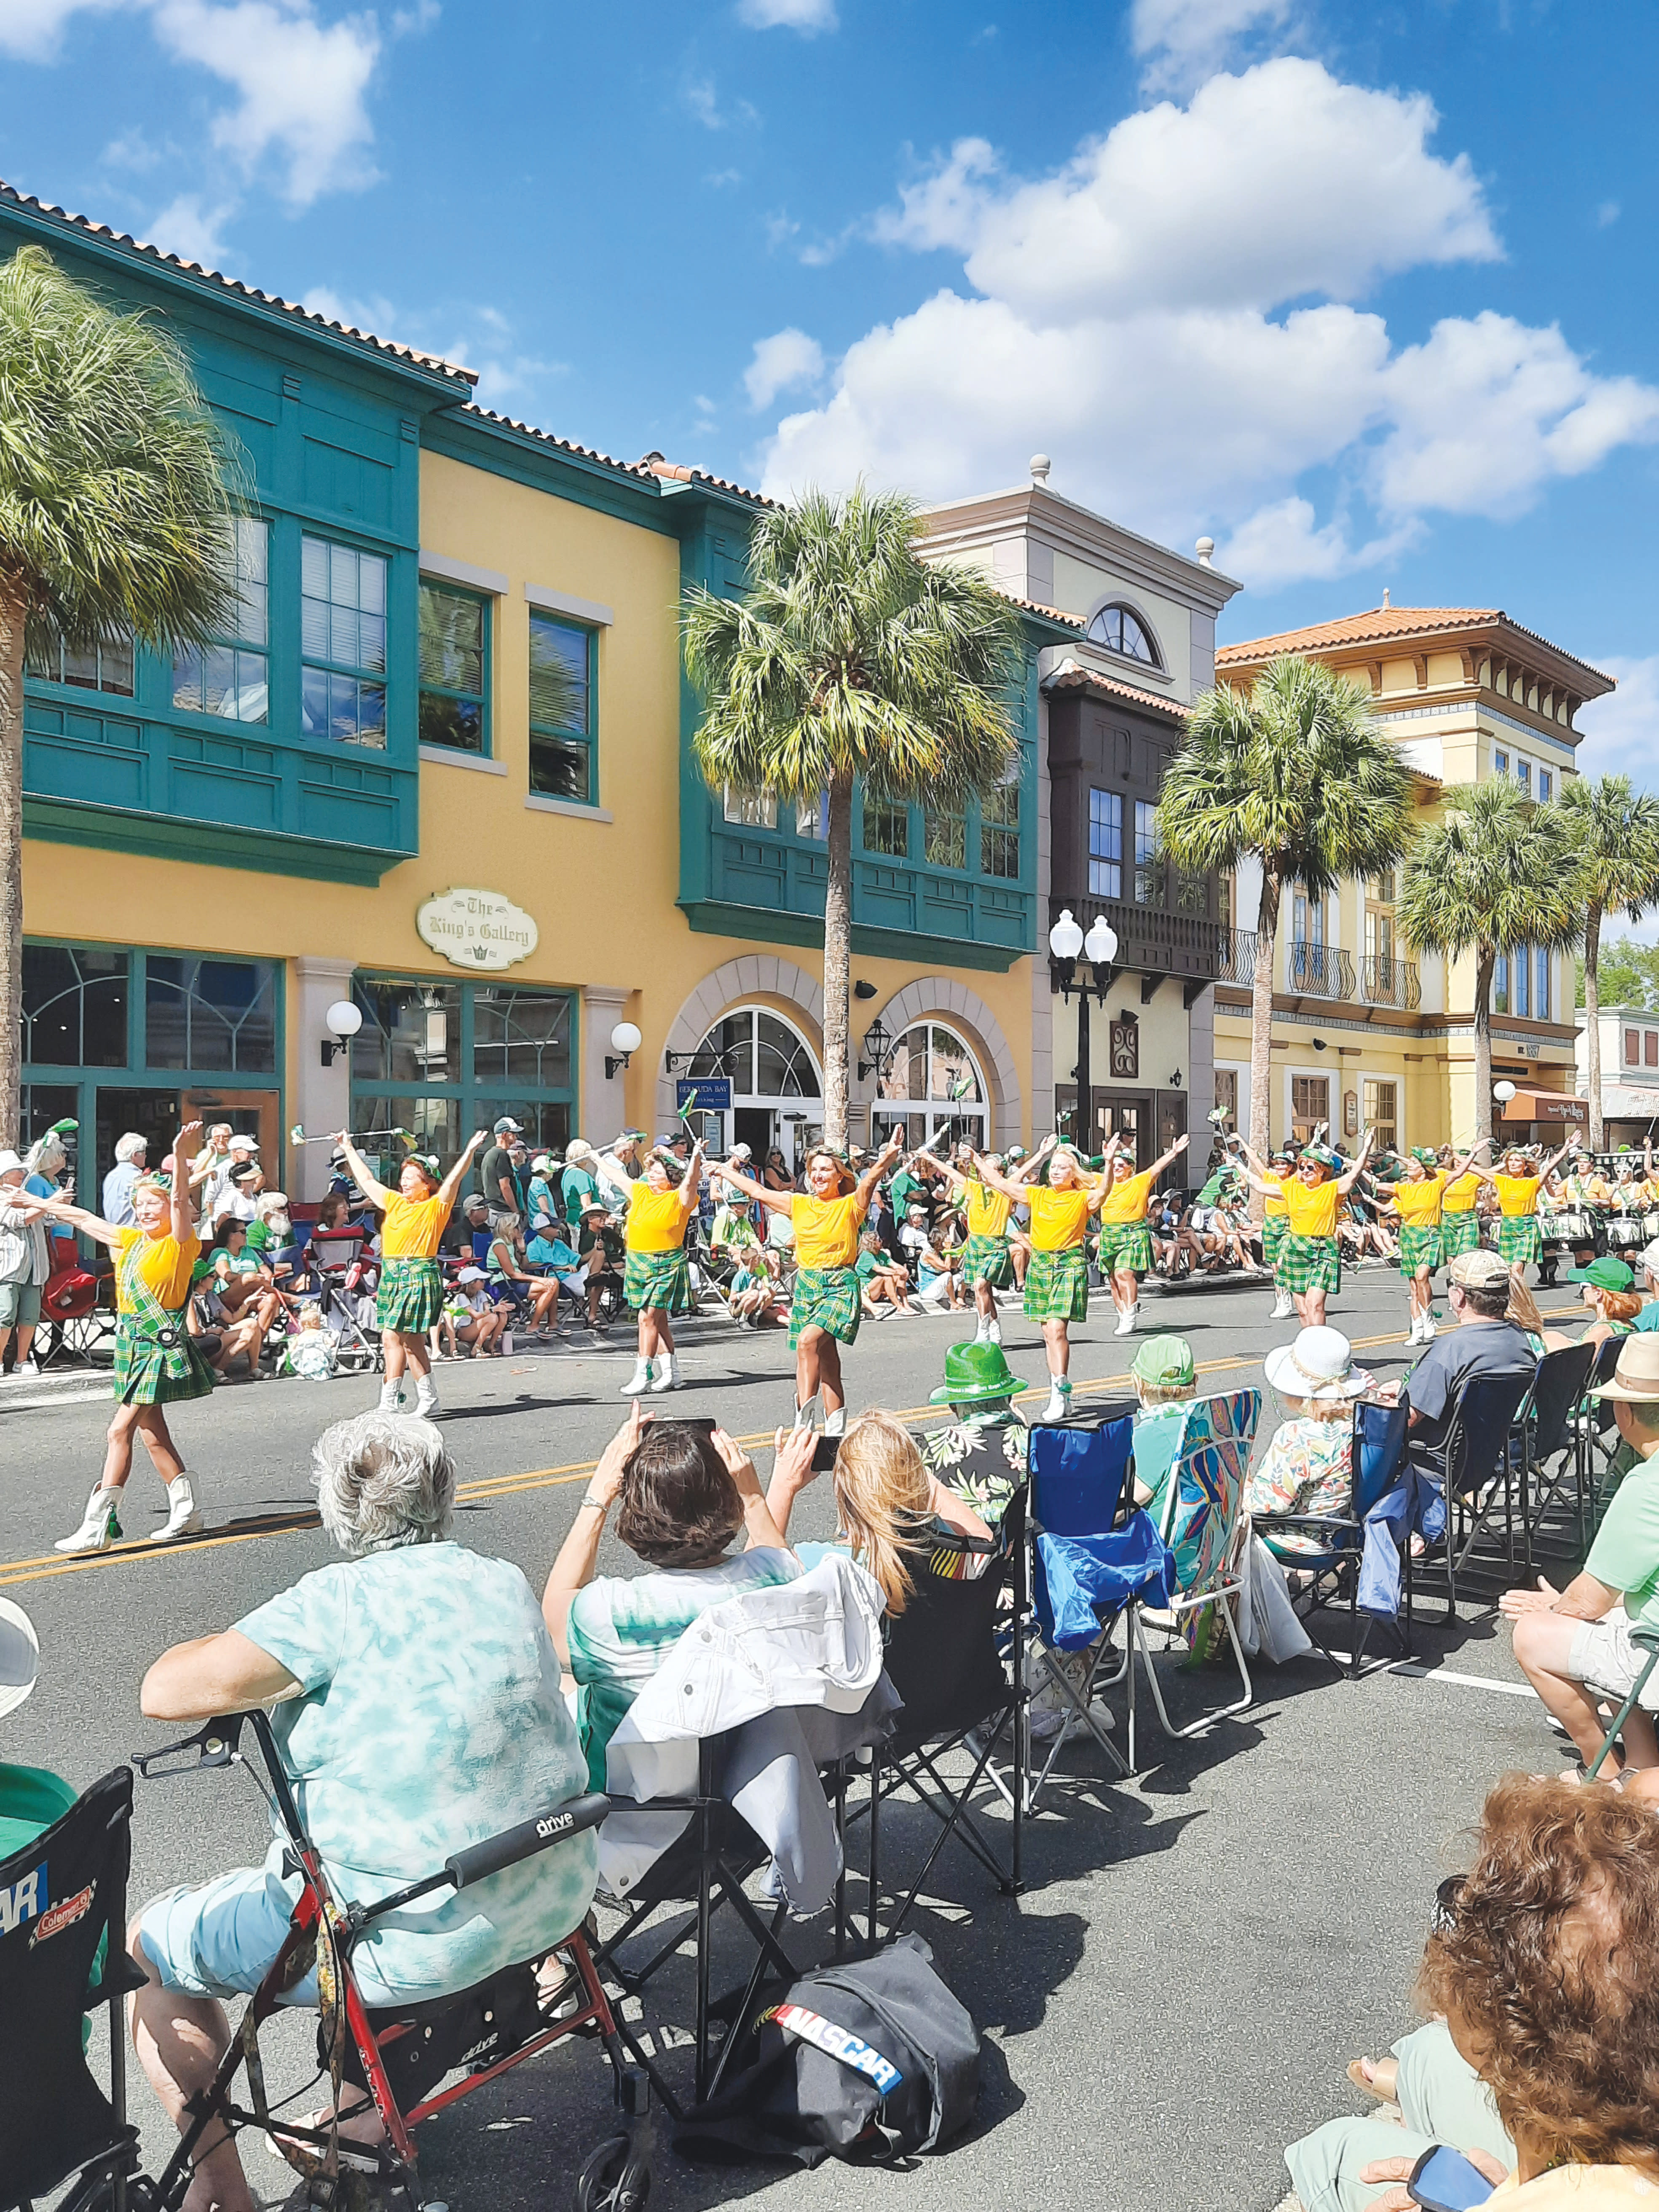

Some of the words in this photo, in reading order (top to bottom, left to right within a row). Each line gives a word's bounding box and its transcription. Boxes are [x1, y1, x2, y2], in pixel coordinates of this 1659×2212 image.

[467, 897, 493, 918] The
[429, 917, 474, 939] King's
[480, 923, 529, 946] Gallery
[536, 1813, 574, 1837] drive
[42, 1900, 79, 1930] Coleman
[461, 2032, 499, 2062] drive
[782, 2006, 896, 2087] NASCAR
